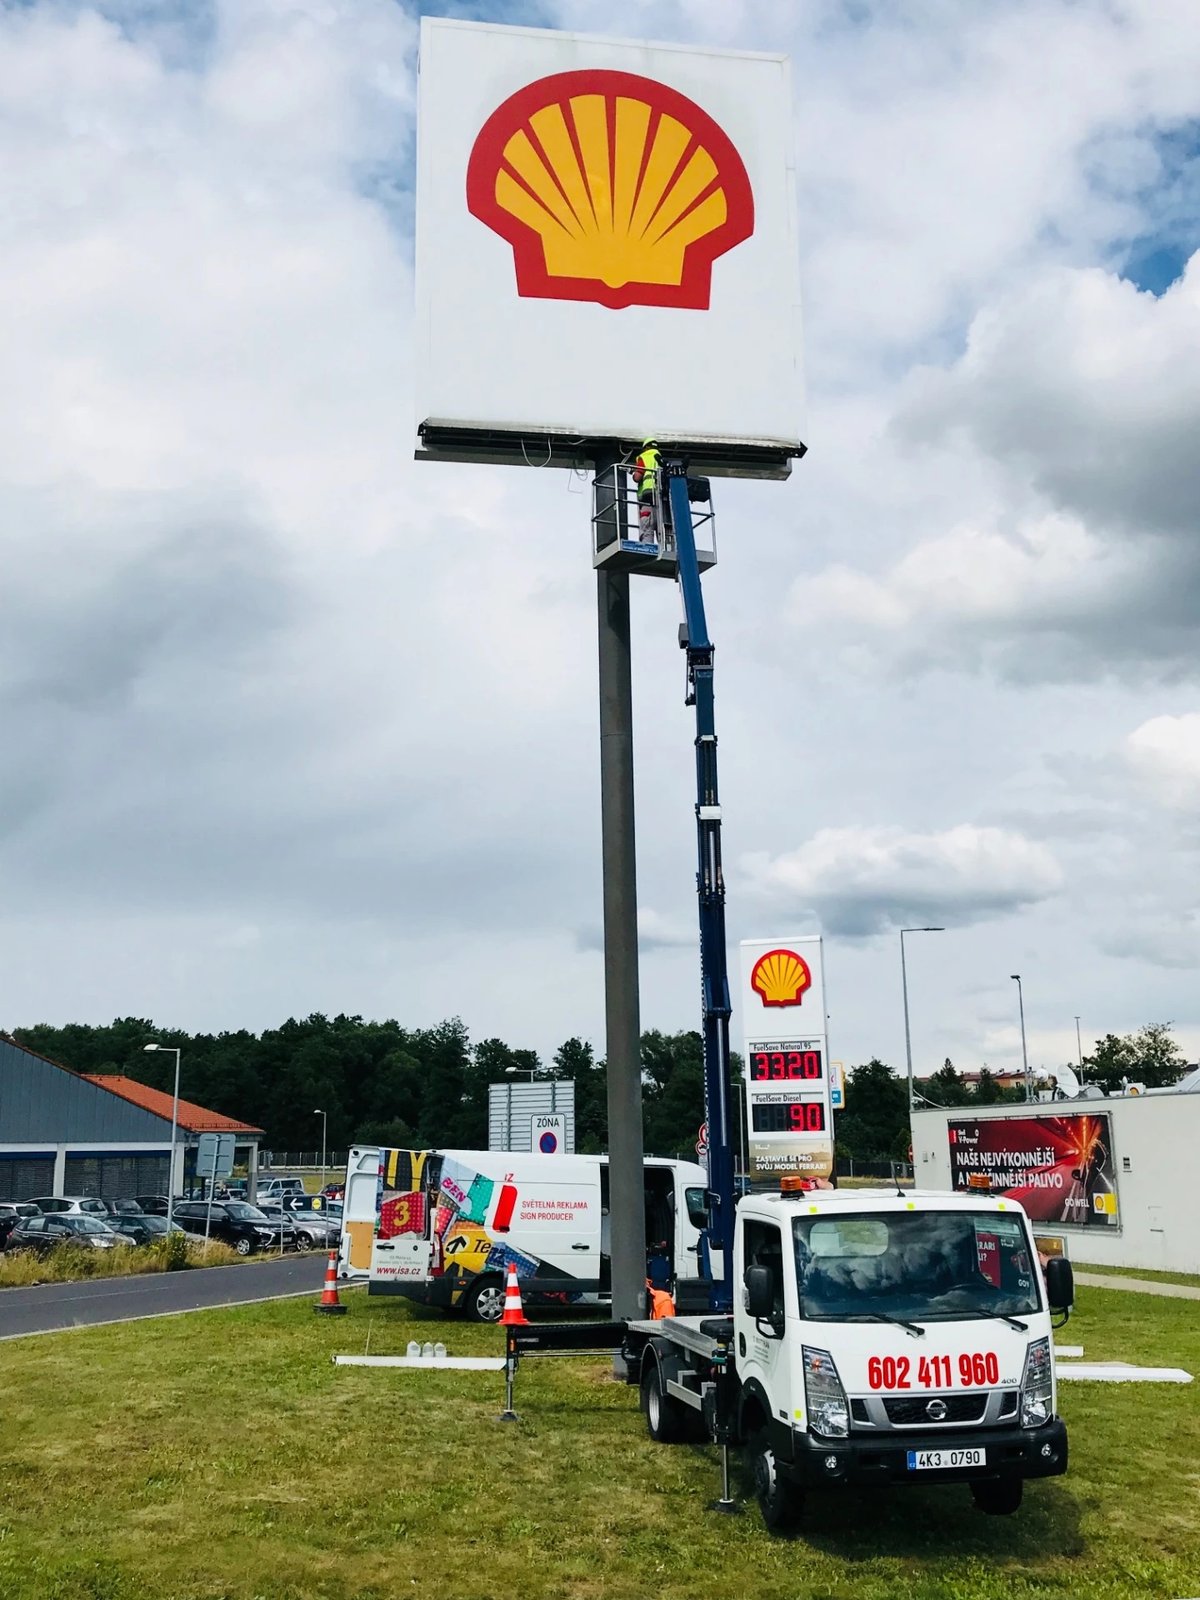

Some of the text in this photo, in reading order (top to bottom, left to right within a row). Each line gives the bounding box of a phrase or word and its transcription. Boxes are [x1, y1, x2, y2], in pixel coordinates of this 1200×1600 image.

[781, 1042, 802, 1050] Natural
[783, 1094, 801, 1102] Diesel
[537, 1116, 560, 1128] ZÓNA
[956, 1147, 1055, 1167] NAŠE NEJVÝKONNĚJŠÍ
[958, 1168, 1063, 1188] A NČINNĚJŠÍ PALIVO
[557, 1201, 588, 1209] REKLAMA
[1065, 1198, 1089, 1208] GO WELL
[393, 1201, 410, 1227] 3
[520, 1212, 573, 1221] SIGN PRODUCER
[376, 1265, 421, 1275] www.isa.cz
[868, 1352, 999, 1389] 602 411 960
[919, 1453, 942, 1467] 4K3
[951, 1451, 980, 1466] 0790
